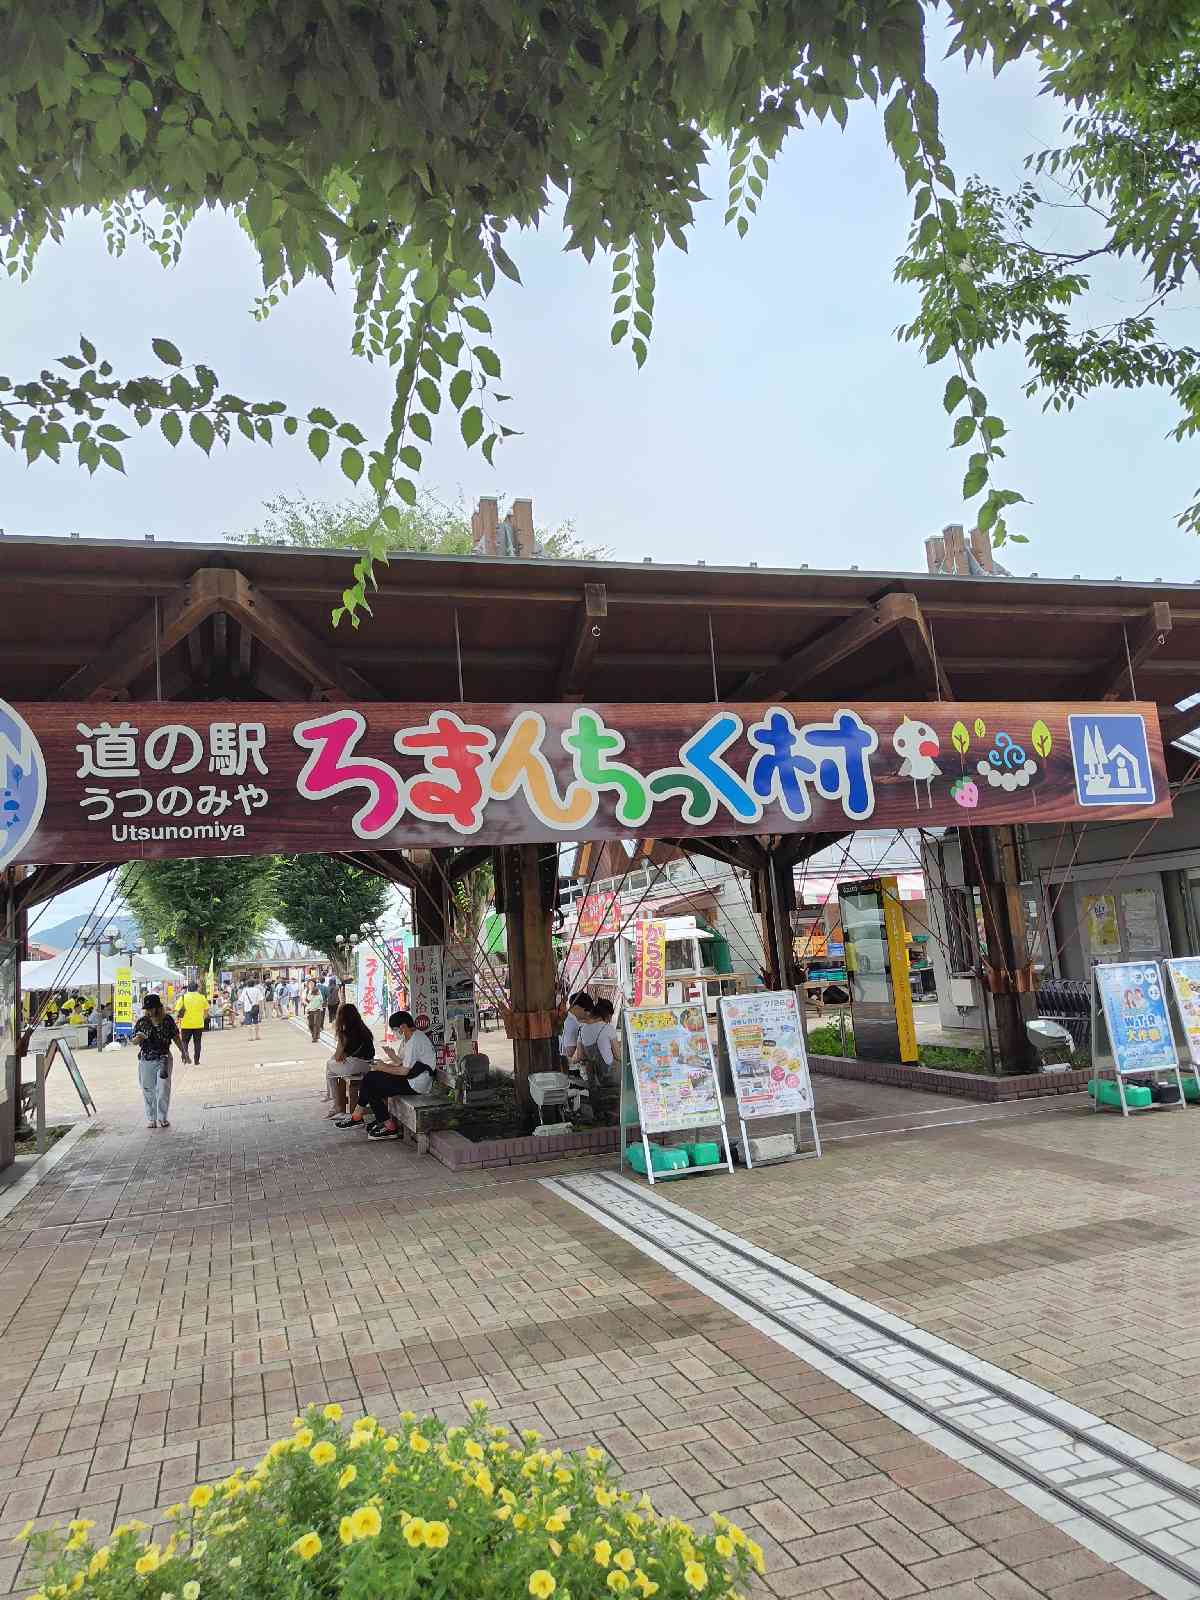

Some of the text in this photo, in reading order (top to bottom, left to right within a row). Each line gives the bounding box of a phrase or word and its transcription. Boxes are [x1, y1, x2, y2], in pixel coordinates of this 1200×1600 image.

[76, 722, 269, 779] 道の駅
[294, 708, 877, 840] ろまんちっく村
[79, 783, 269, 821] うつのみや
[111, 821, 246, 842] Utsunomiya
